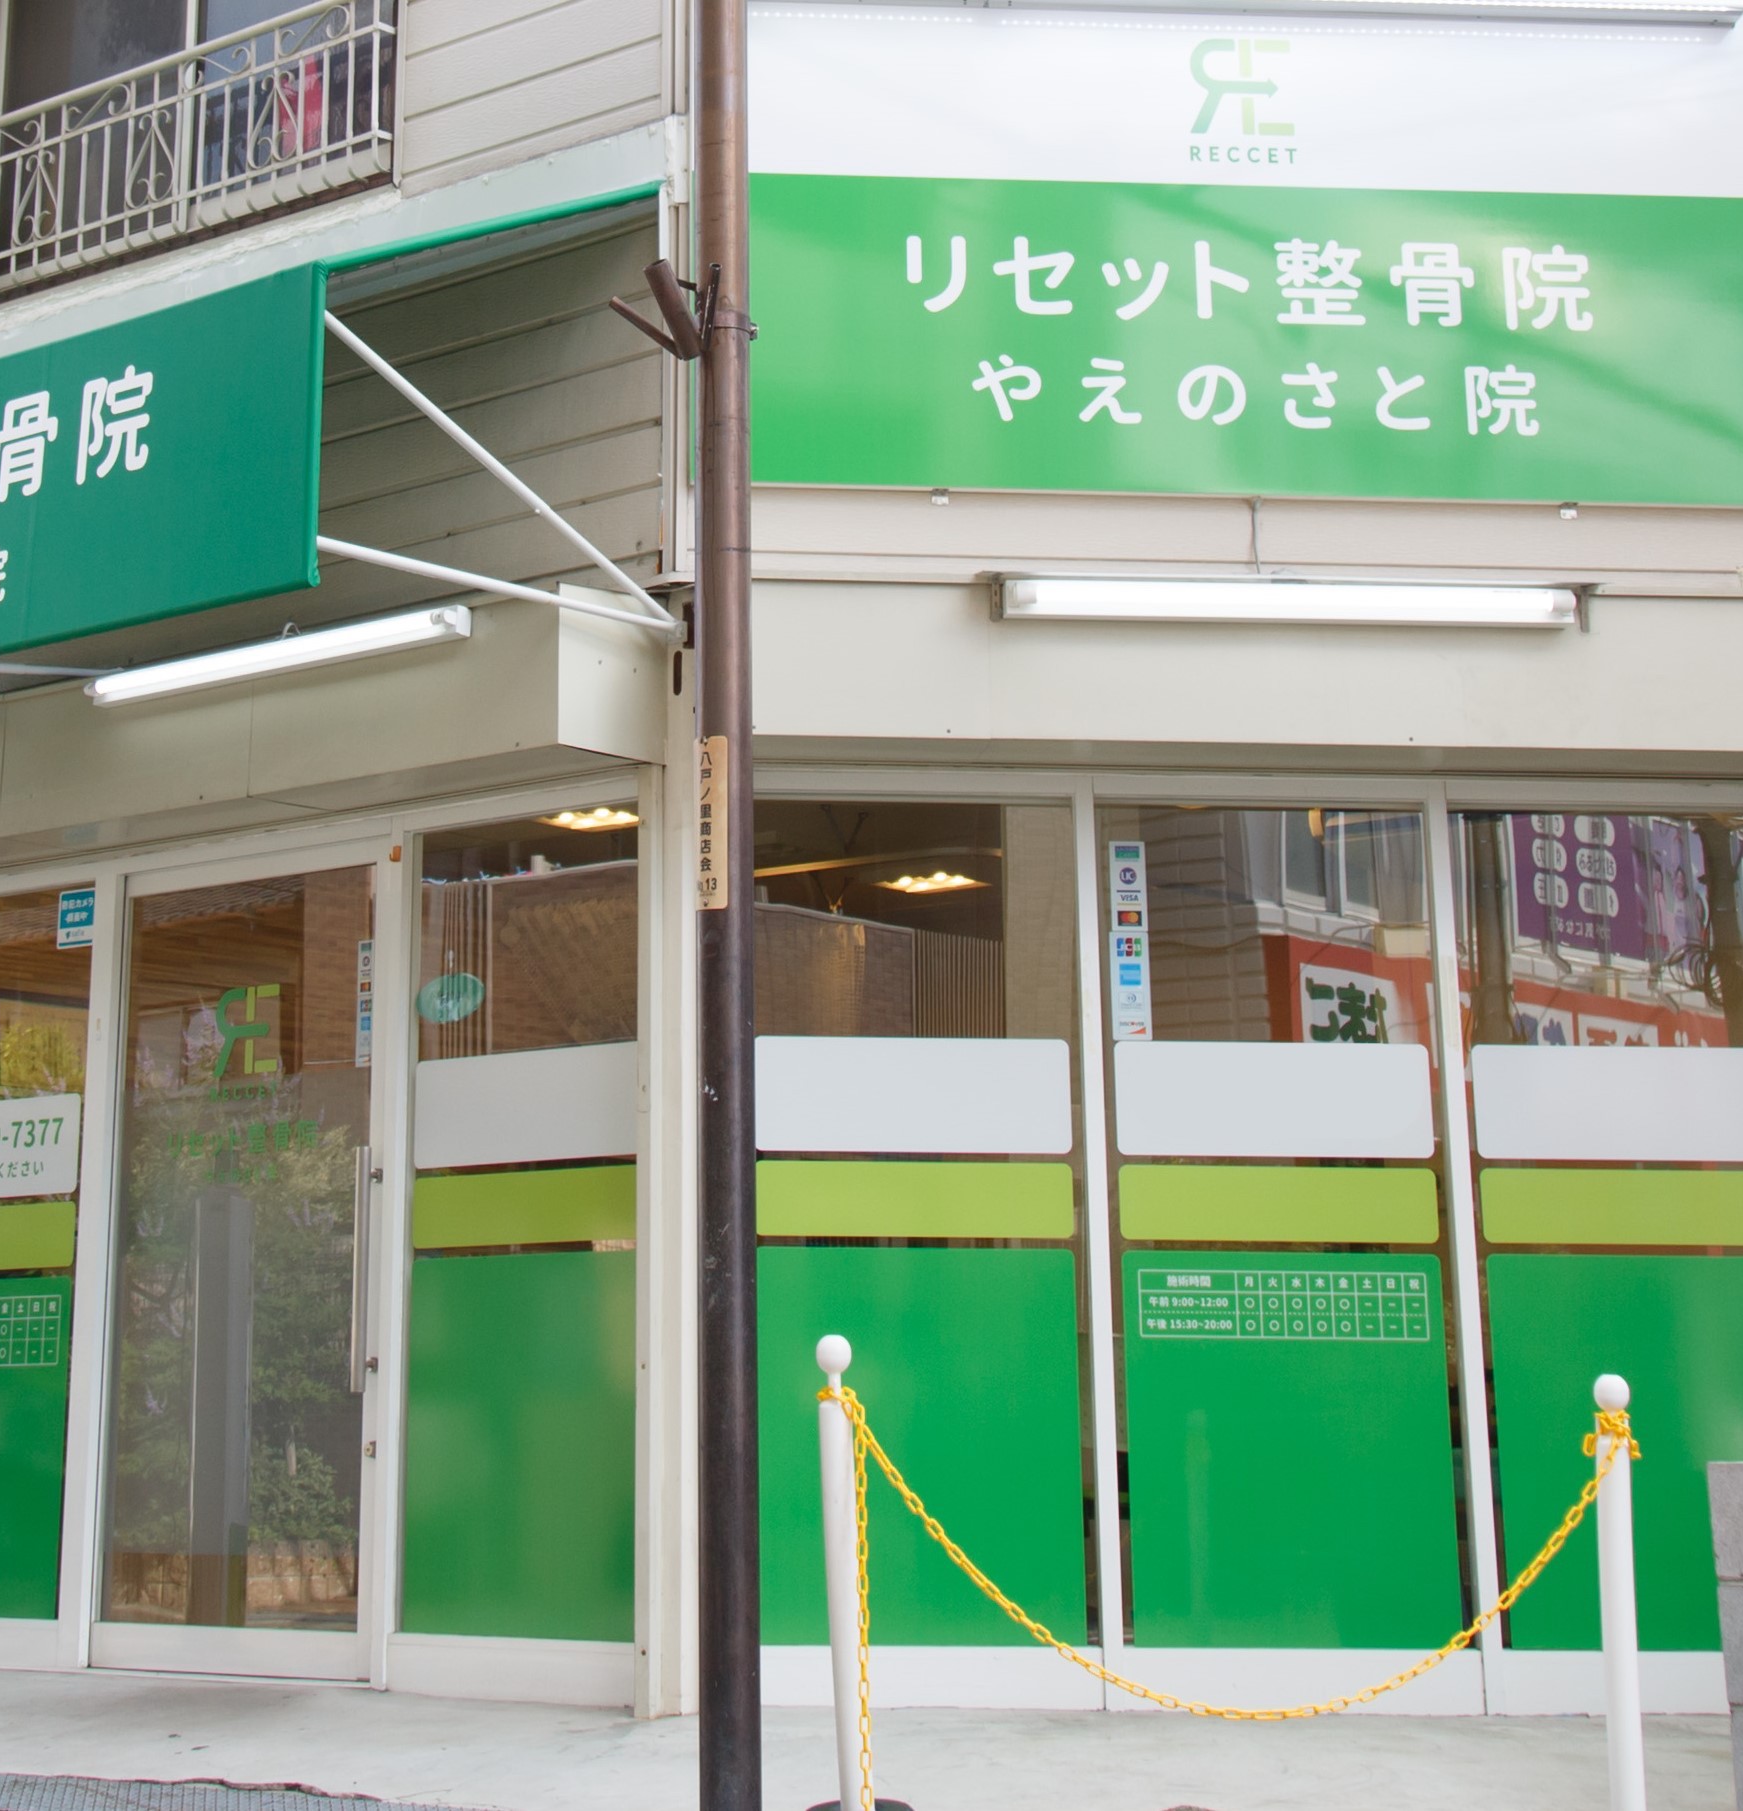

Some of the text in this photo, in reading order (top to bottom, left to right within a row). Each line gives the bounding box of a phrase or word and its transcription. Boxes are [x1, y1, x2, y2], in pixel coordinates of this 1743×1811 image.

[1189, 145, 1297, 165] RECCET
[905, 235, 1594, 332] リセット整骨院
[971, 354, 1540, 437] やえのさと院
[699, 750, 713, 873] 八戸ノ里商店会
[1119, 893, 1140, 902] VISA
[1244, 1276, 1254, 1287] 月
[1267, 1277, 1278, 1288] 火
[1291, 1277, 1302, 1288] 水
[1315, 1277, 1325, 1288] 木
[1338, 1277, 1349, 1289] 金
[1362, 1278, 1372, 1289] 土
[1386, 1278, 1395, 1289] 日
[1148, 1296, 1169, 1308] 午前
